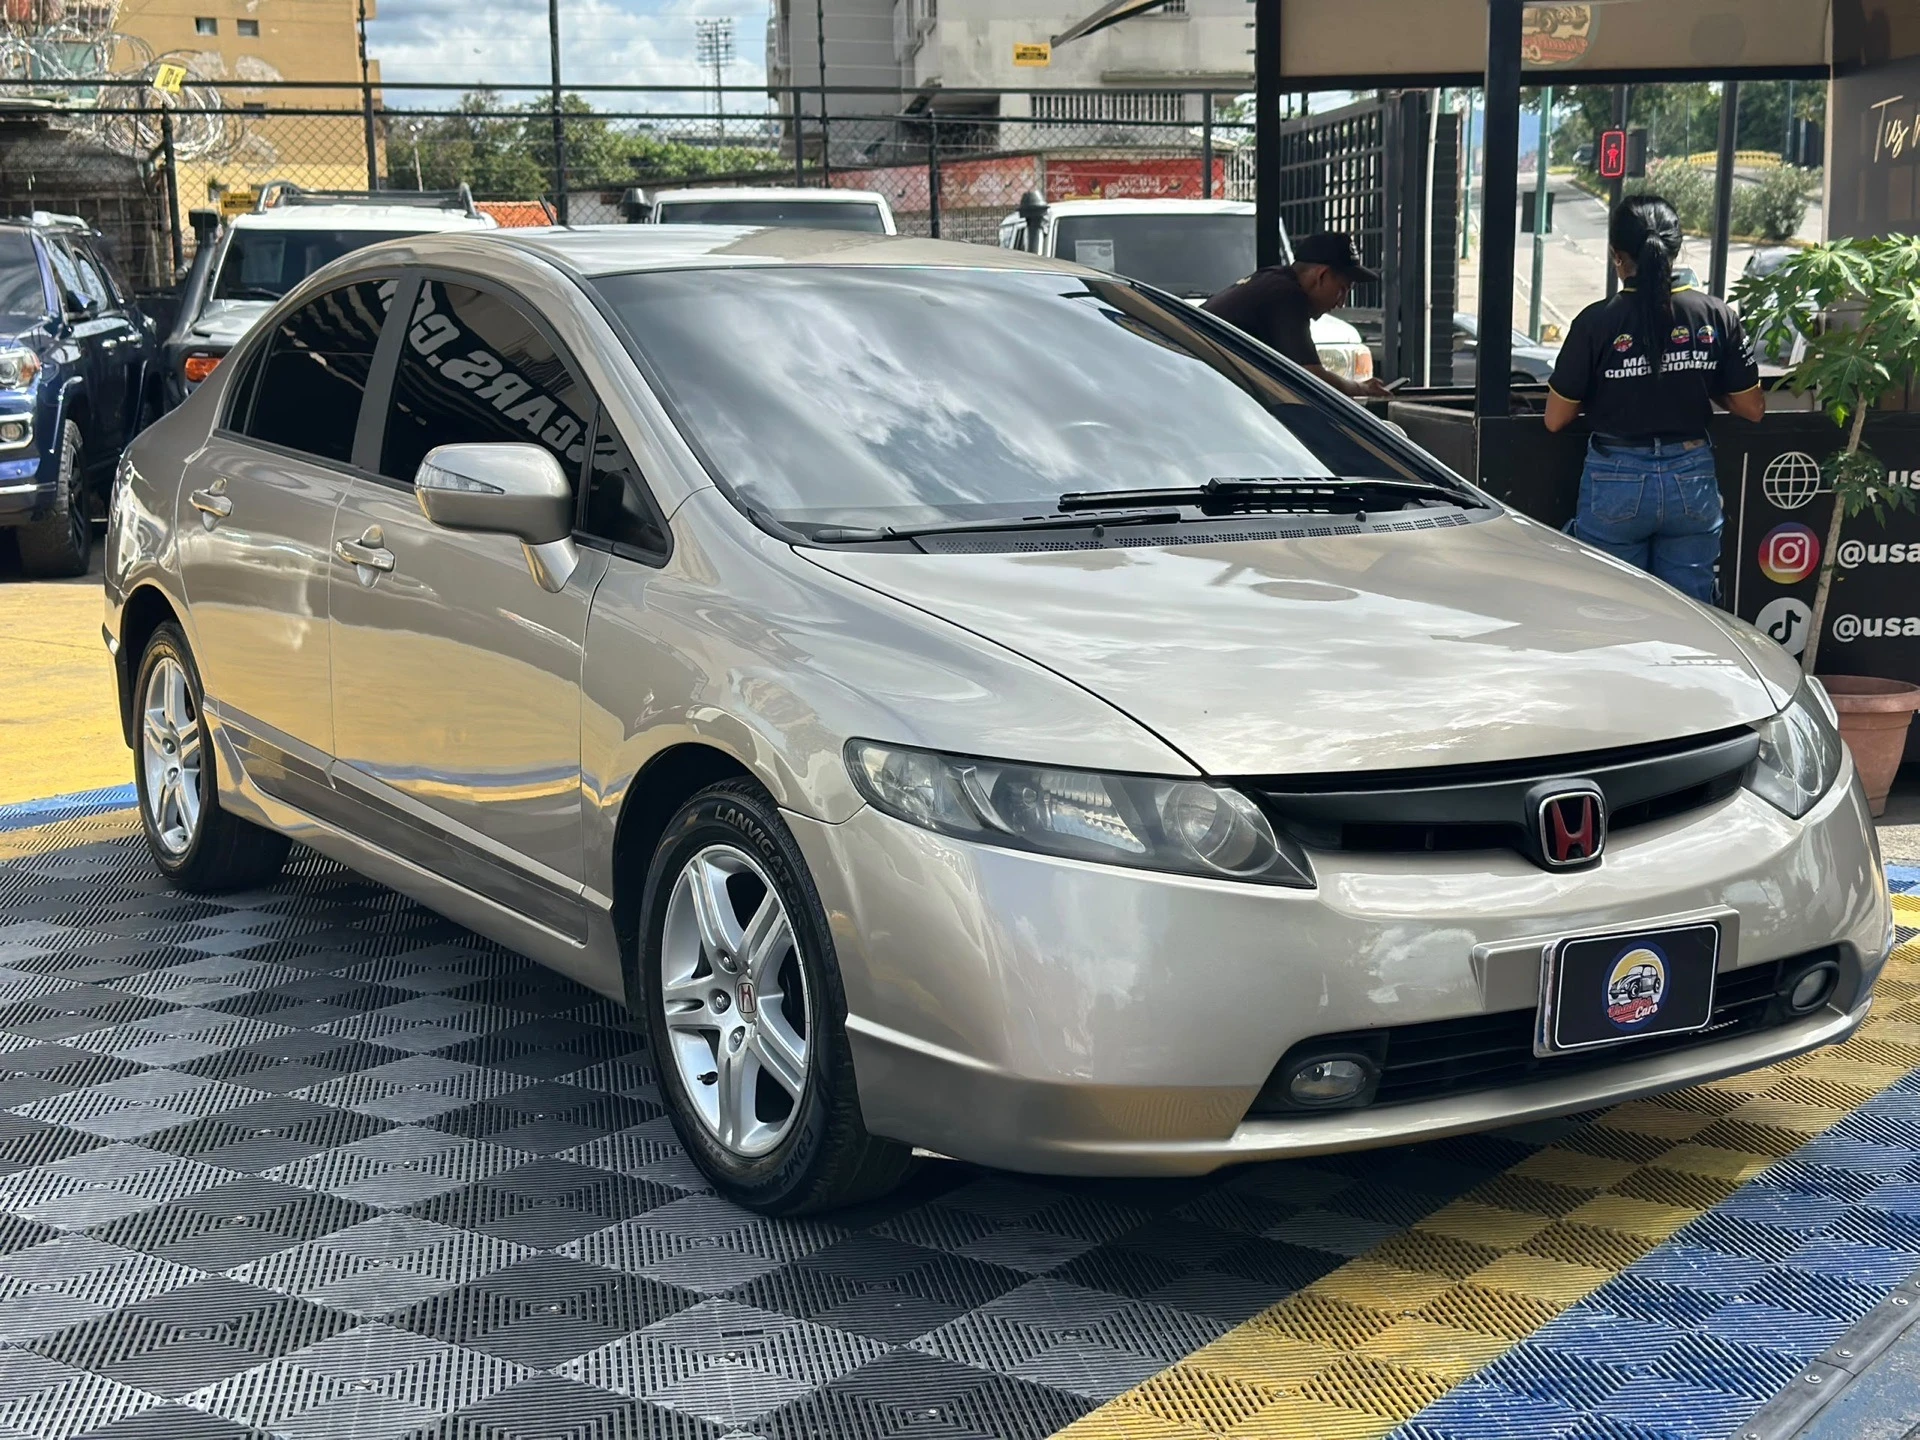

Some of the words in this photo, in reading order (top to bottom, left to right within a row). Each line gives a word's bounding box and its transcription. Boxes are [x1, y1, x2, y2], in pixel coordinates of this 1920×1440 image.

[1870, 95, 1909, 163] Tus
[1837, 540, 1920, 569] @usa
[1832, 613, 1920, 642] @usa
[1635, 1003, 1658, 1019] Cars
